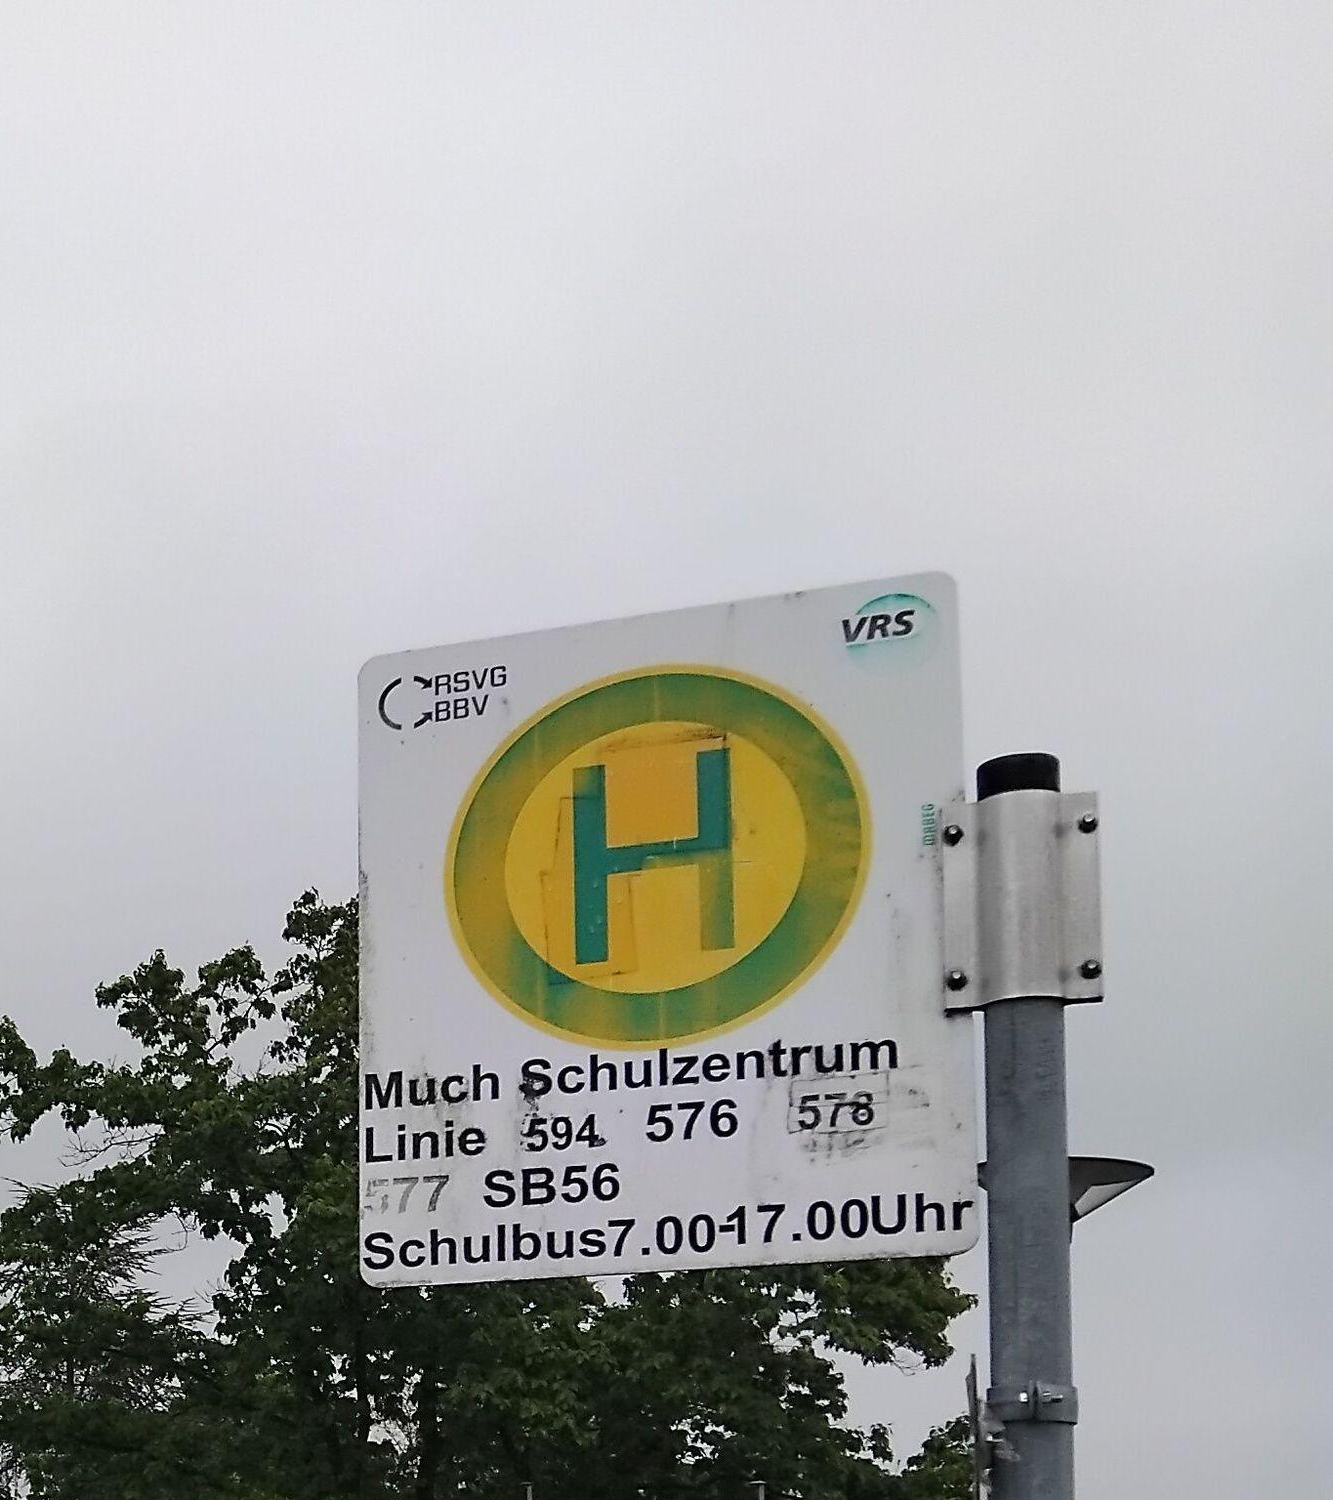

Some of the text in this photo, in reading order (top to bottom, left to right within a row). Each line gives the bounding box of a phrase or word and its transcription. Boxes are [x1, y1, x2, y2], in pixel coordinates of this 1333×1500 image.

[841, 609, 915, 643] VRS
[434, 665, 507, 696] RSVG
[434, 694, 489, 722] BBV
[572, 748, 735, 965] H
[364, 1039, 898, 1110] Much Schulzentrum
[365, 1091, 875, 1163] Linie 594 576 578
[364, 1163, 620, 1214] 577 SB56
